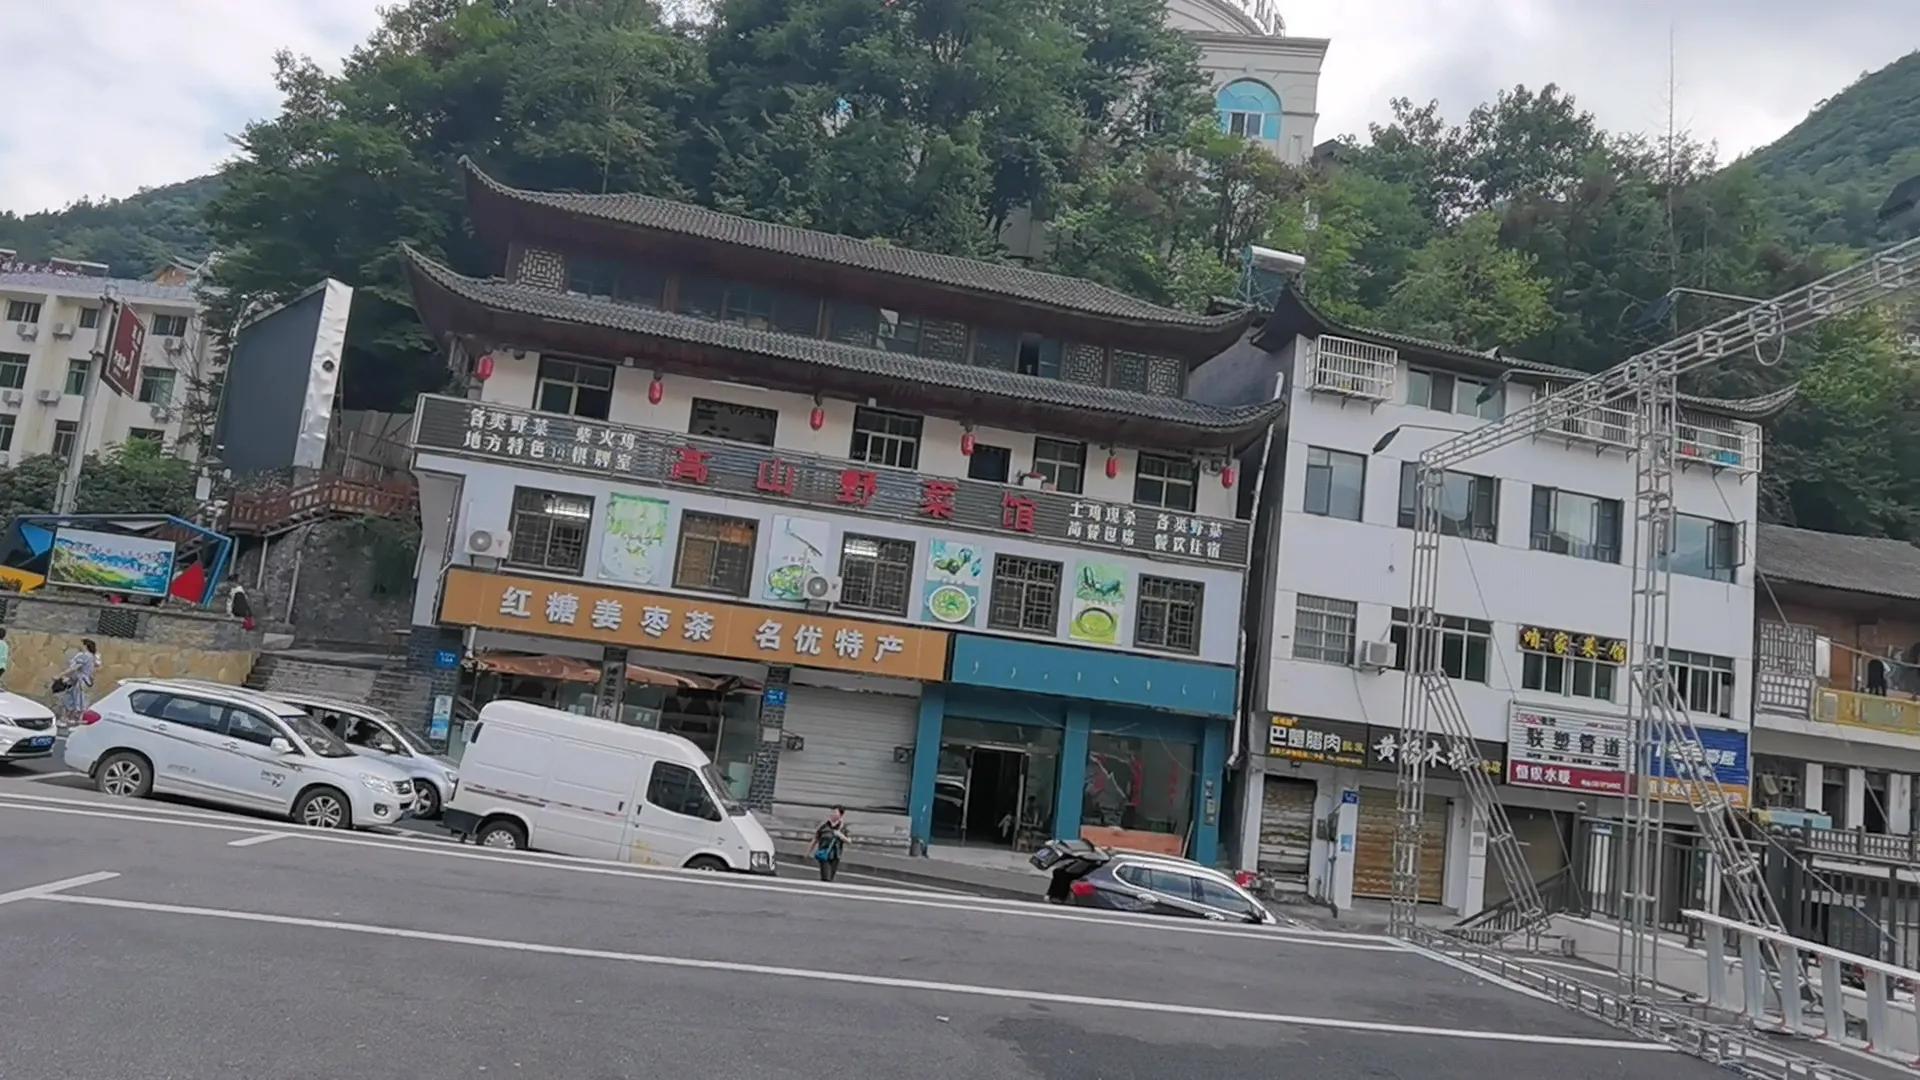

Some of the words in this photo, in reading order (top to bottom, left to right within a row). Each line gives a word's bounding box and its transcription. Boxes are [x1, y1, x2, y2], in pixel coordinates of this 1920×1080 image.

[463, 430, 545, 459] 地方特色
[572, 446, 631, 472] 棋牌室
[576, 426, 635, 450] 柴火鸡
[671, 447, 1038, 533] 高山野菜馆
[1069, 501, 1136, 526] 土鸡现杀
[1154, 534, 1220, 559] 餐饮住宿
[500, 586, 715, 641] 红糖姜枣茶
[755, 619, 904, 663] 名优特产
[1526, 727, 1620, 757] 联塑管道
